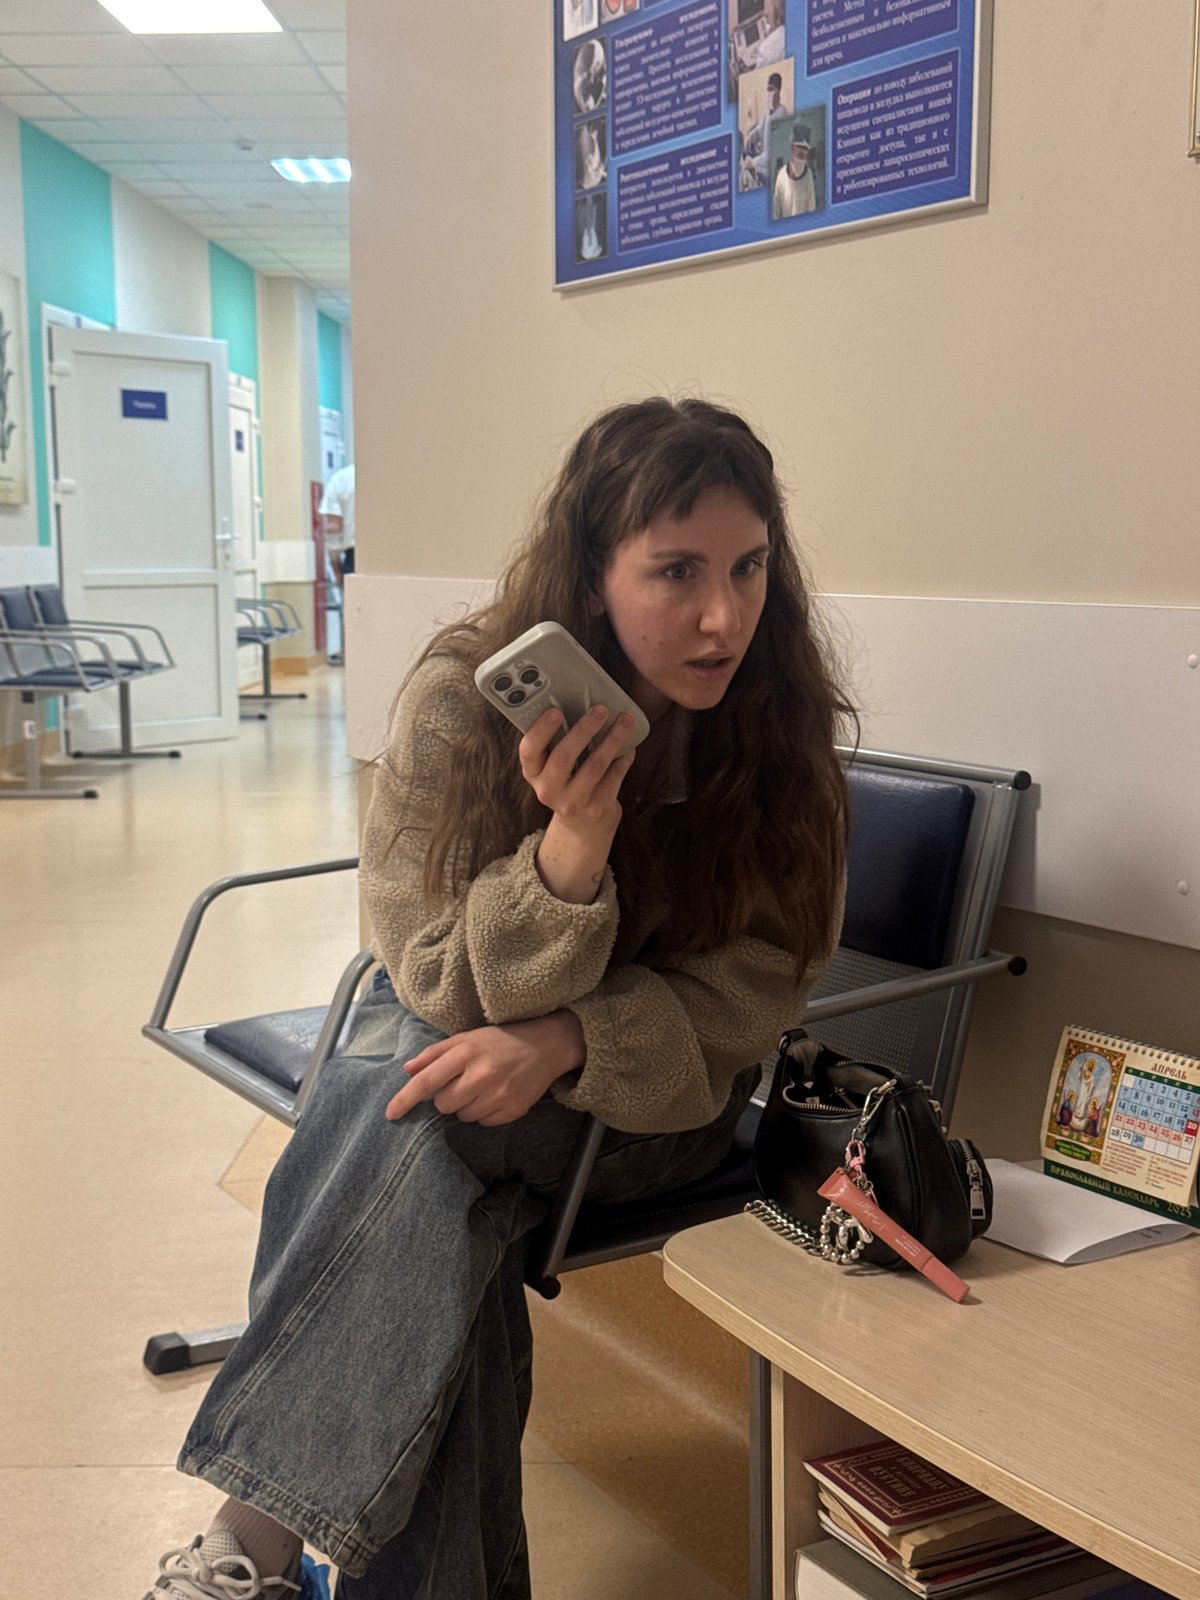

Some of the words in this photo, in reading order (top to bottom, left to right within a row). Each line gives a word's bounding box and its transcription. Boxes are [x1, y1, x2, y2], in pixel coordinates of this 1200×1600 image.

[837, 88, 872, 105] Операции
[870, 131, 882, 141] как
[914, 134, 926, 144] так
[1151, 1063, 1188, 1080] АПРЕЛЬ
[1118, 1102, 1126, 1110] 14
[1129, 1105, 1137, 1113] 15
[1141, 1109, 1149, 1117] 16
[1153, 1112, 1161, 1120] 17
[1165, 1116, 1172, 1124] 18
[1177, 1119, 1185, 1128] 19
[1187, 1121, 1196, 1129] 20
[1111, 1128, 1120, 1136] 28
[1123, 1131, 1131, 1139] 29
[1133, 1134, 1143, 1143] 30
[1138, 1121, 1146, 1130] 23
[1149, 1125, 1157, 1134] 24
[1161, 1129, 1169, 1137] 25
[1173, 1133, 1181, 1141] 26
[1185, 1136, 1193, 1144] 27
[1167, 1202, 1192, 1218] 2025
